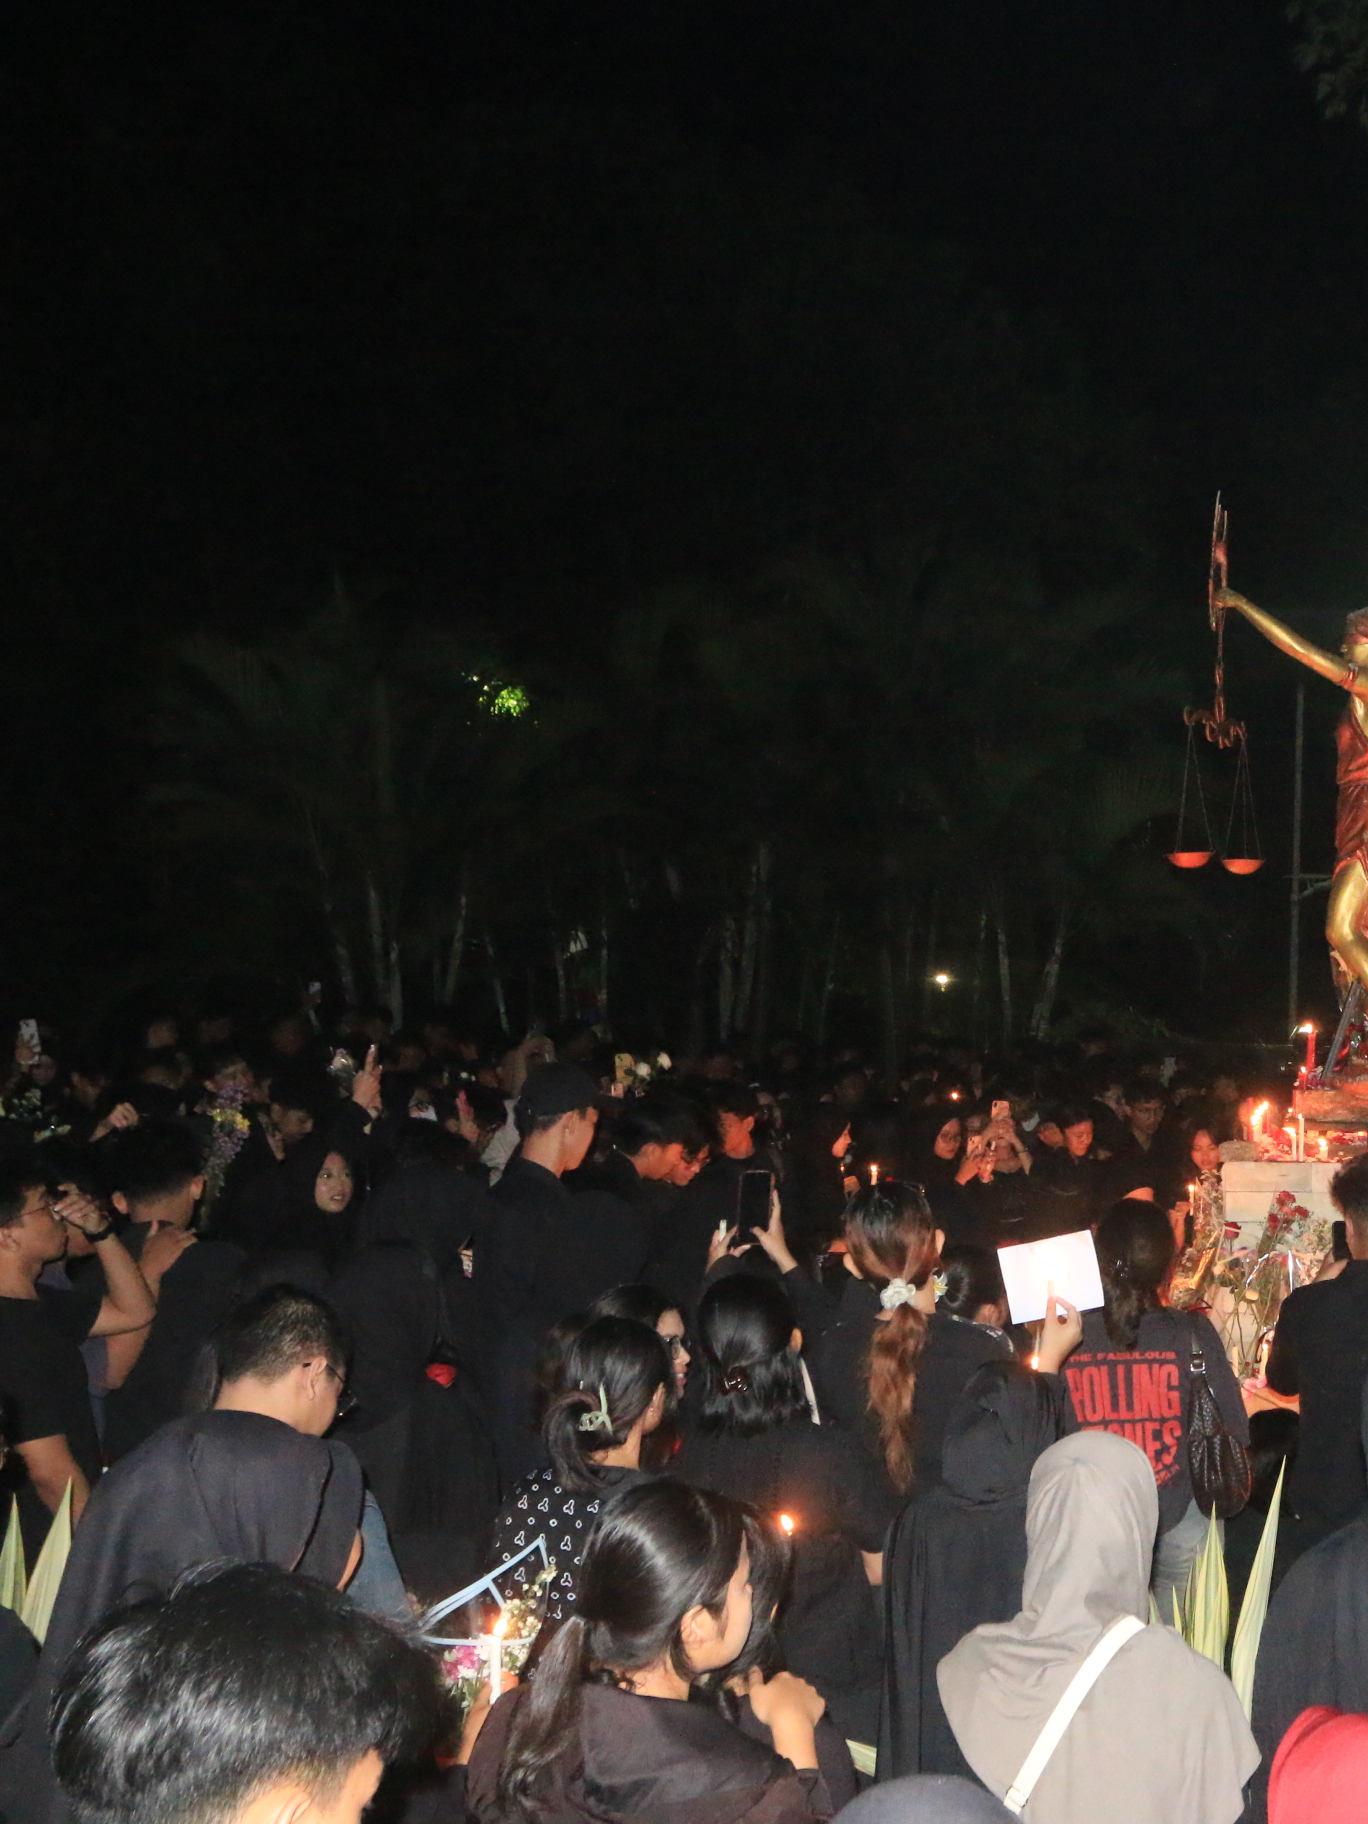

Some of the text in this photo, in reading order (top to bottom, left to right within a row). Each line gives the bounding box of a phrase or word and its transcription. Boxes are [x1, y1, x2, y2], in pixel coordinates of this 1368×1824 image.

[1069, 1351, 1177, 1363] THE FABULOUS
[1065, 1364, 1182, 1423] ROLLING
